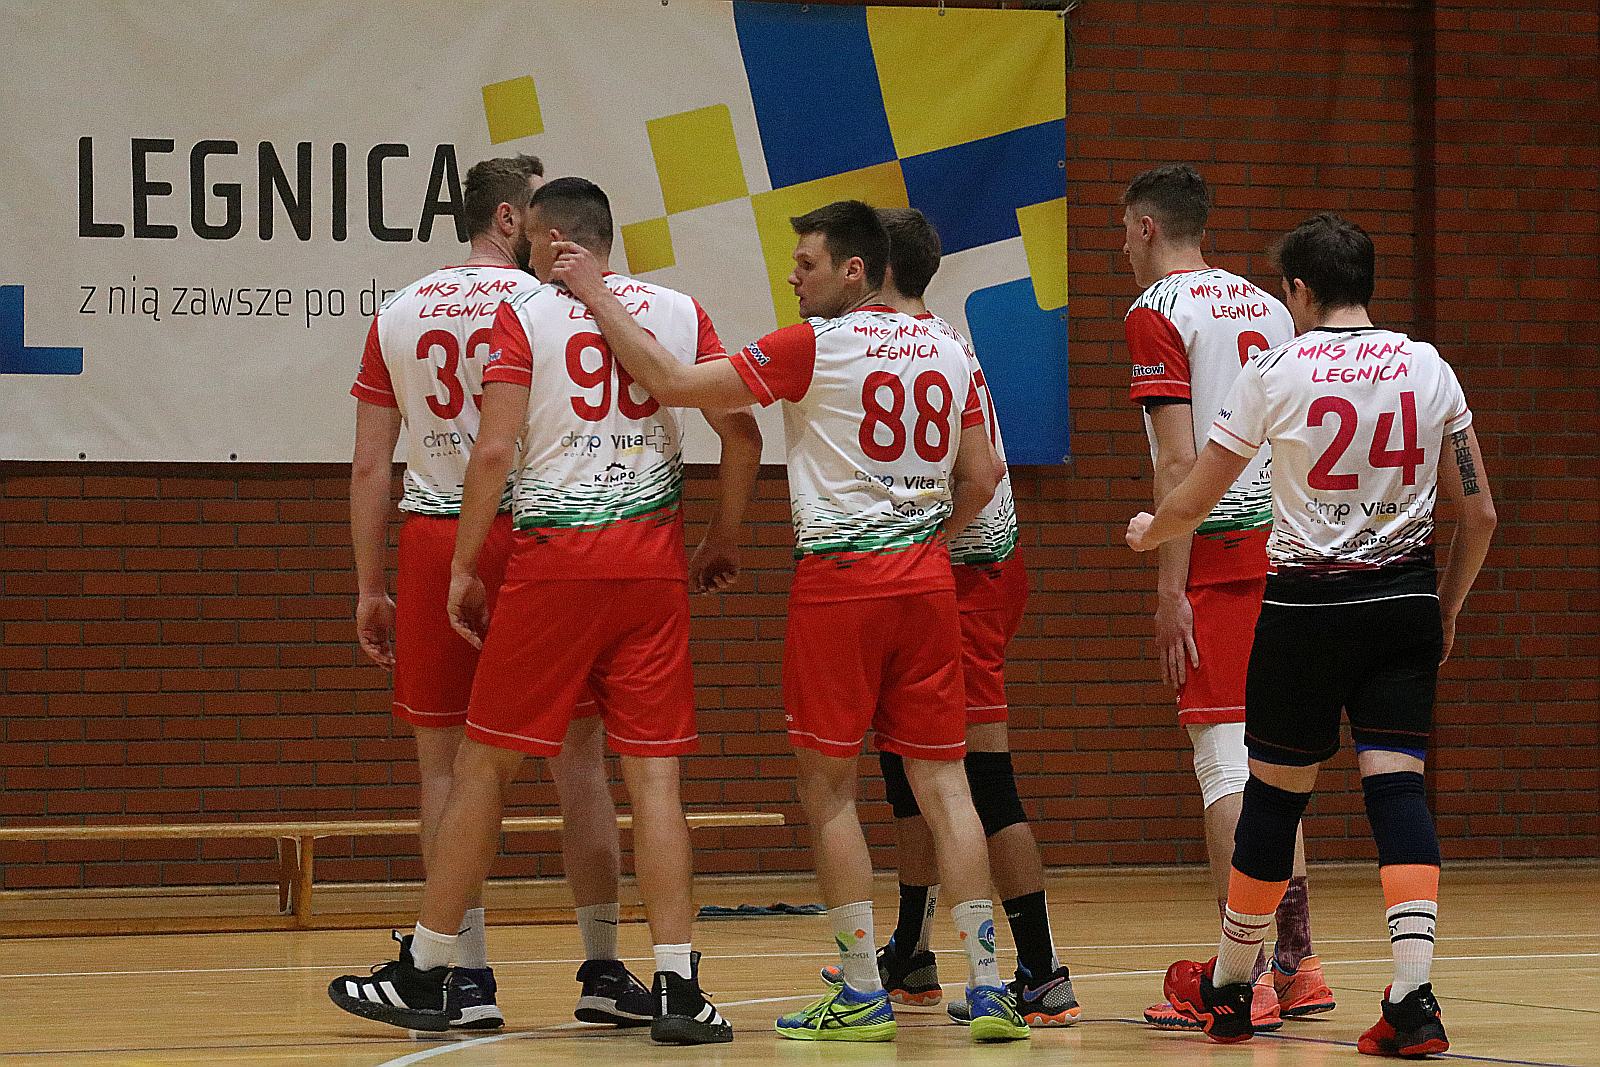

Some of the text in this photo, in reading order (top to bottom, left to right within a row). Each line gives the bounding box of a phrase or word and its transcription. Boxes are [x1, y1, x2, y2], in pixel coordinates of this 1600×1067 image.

[79, 137, 470, 243] LEGNICA
[415, 281, 460, 298] MKS
[1190, 284, 1222, 299] MKS
[80, 286, 96, 315] z
[109, 275, 160, 322] nią
[171, 286, 292, 317] zawsze
[305, 287, 345, 329] po
[419, 302, 498, 321] LEGNIC
[1211, 302, 1271, 321] LEGNICA
[866, 343, 939, 361] LEGNICA
[1297, 341, 1411, 361] MKS IKAR
[1311, 363, 1408, 385] LEGNICA
[858, 370, 953, 463] 88
[611, 434, 644, 450] Vita
[1307, 391, 1424, 490] 24
[904, 476, 935, 489] Vita
[1360, 501, 1397, 516] Vita
